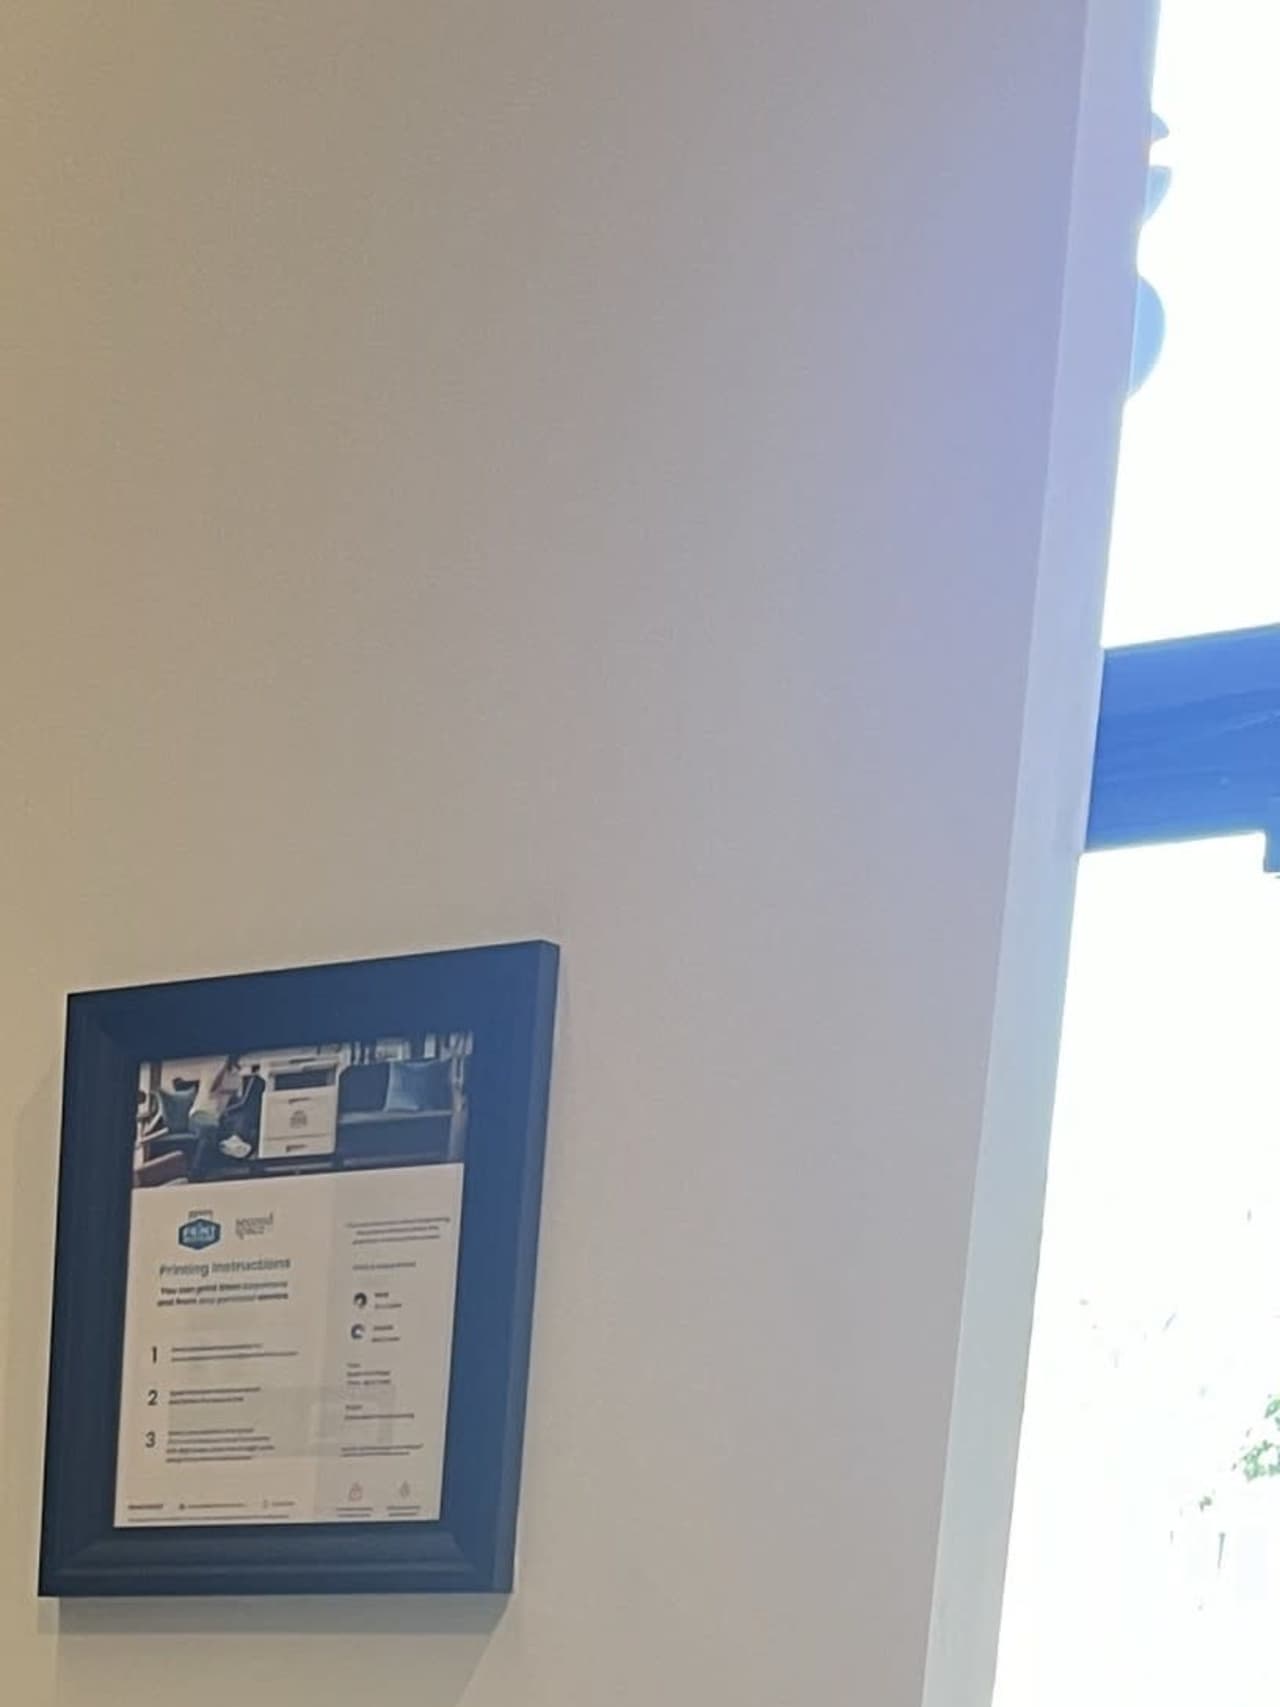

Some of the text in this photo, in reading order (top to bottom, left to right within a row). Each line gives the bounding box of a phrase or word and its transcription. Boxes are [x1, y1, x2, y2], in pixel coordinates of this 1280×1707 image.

[151, 1345, 158, 1364] 1
[147, 1389, 159, 1406] 2
[145, 1431, 156, 1448] 3
